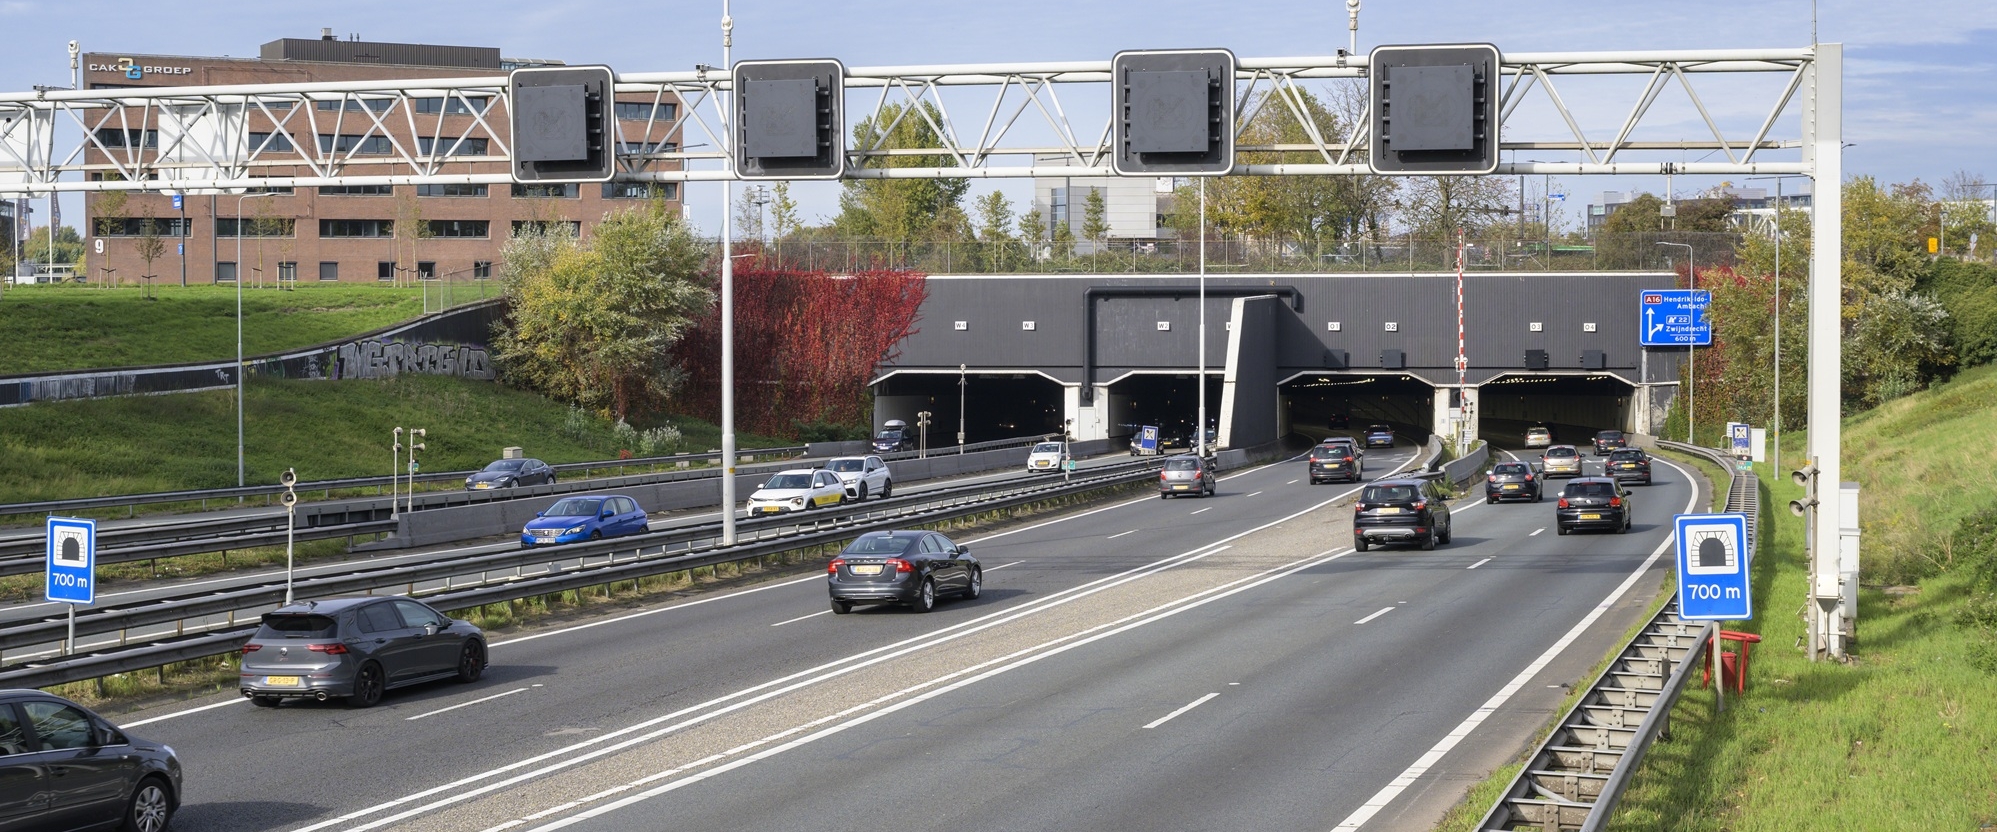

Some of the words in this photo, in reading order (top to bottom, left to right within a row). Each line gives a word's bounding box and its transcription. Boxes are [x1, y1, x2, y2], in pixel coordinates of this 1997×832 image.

[89, 63, 117, 72] CAK
[143, 65, 191, 75] GROEP
[94, 239, 104, 254] 9
[1665, 325, 1708, 334] Zwijndrecht
[52, 572, 75, 587] 700
[77, 577, 88, 588] m
[1687, 584, 1721, 600] 700
[1725, 587, 1741, 599] m
